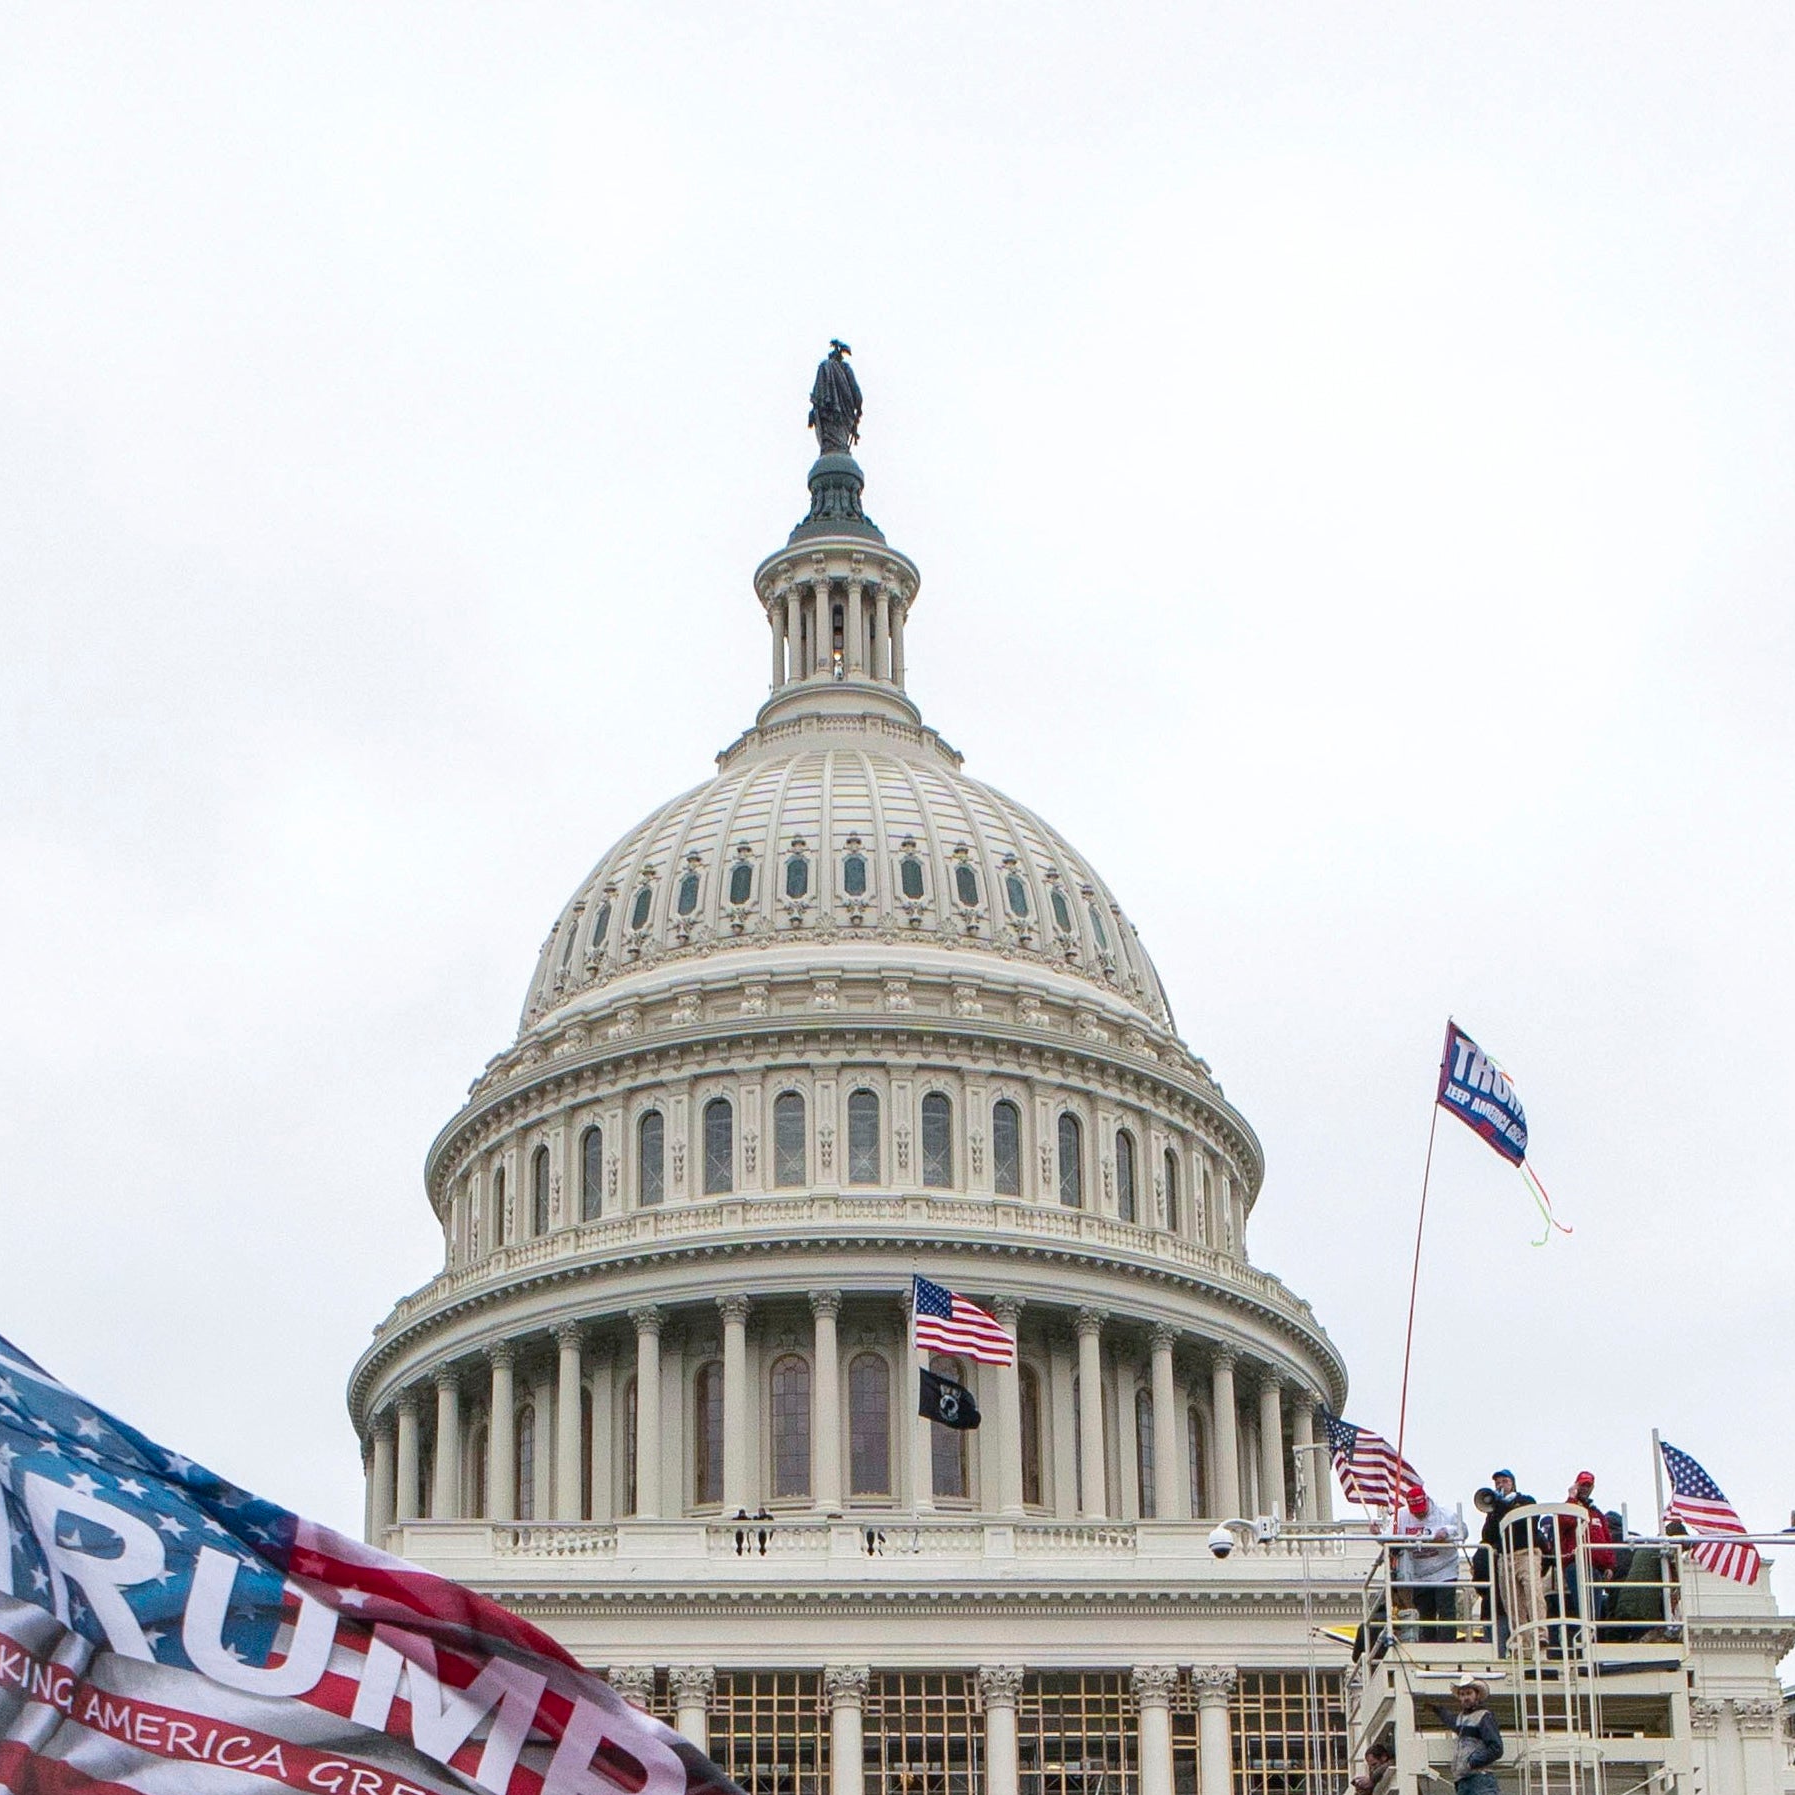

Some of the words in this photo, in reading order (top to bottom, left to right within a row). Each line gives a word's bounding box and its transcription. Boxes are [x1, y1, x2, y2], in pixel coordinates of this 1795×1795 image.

[1444, 1082, 1469, 1104] KEEP
[1470, 1098, 1508, 1135] AMERICA
[86, 1697, 289, 1781] AMERICA
